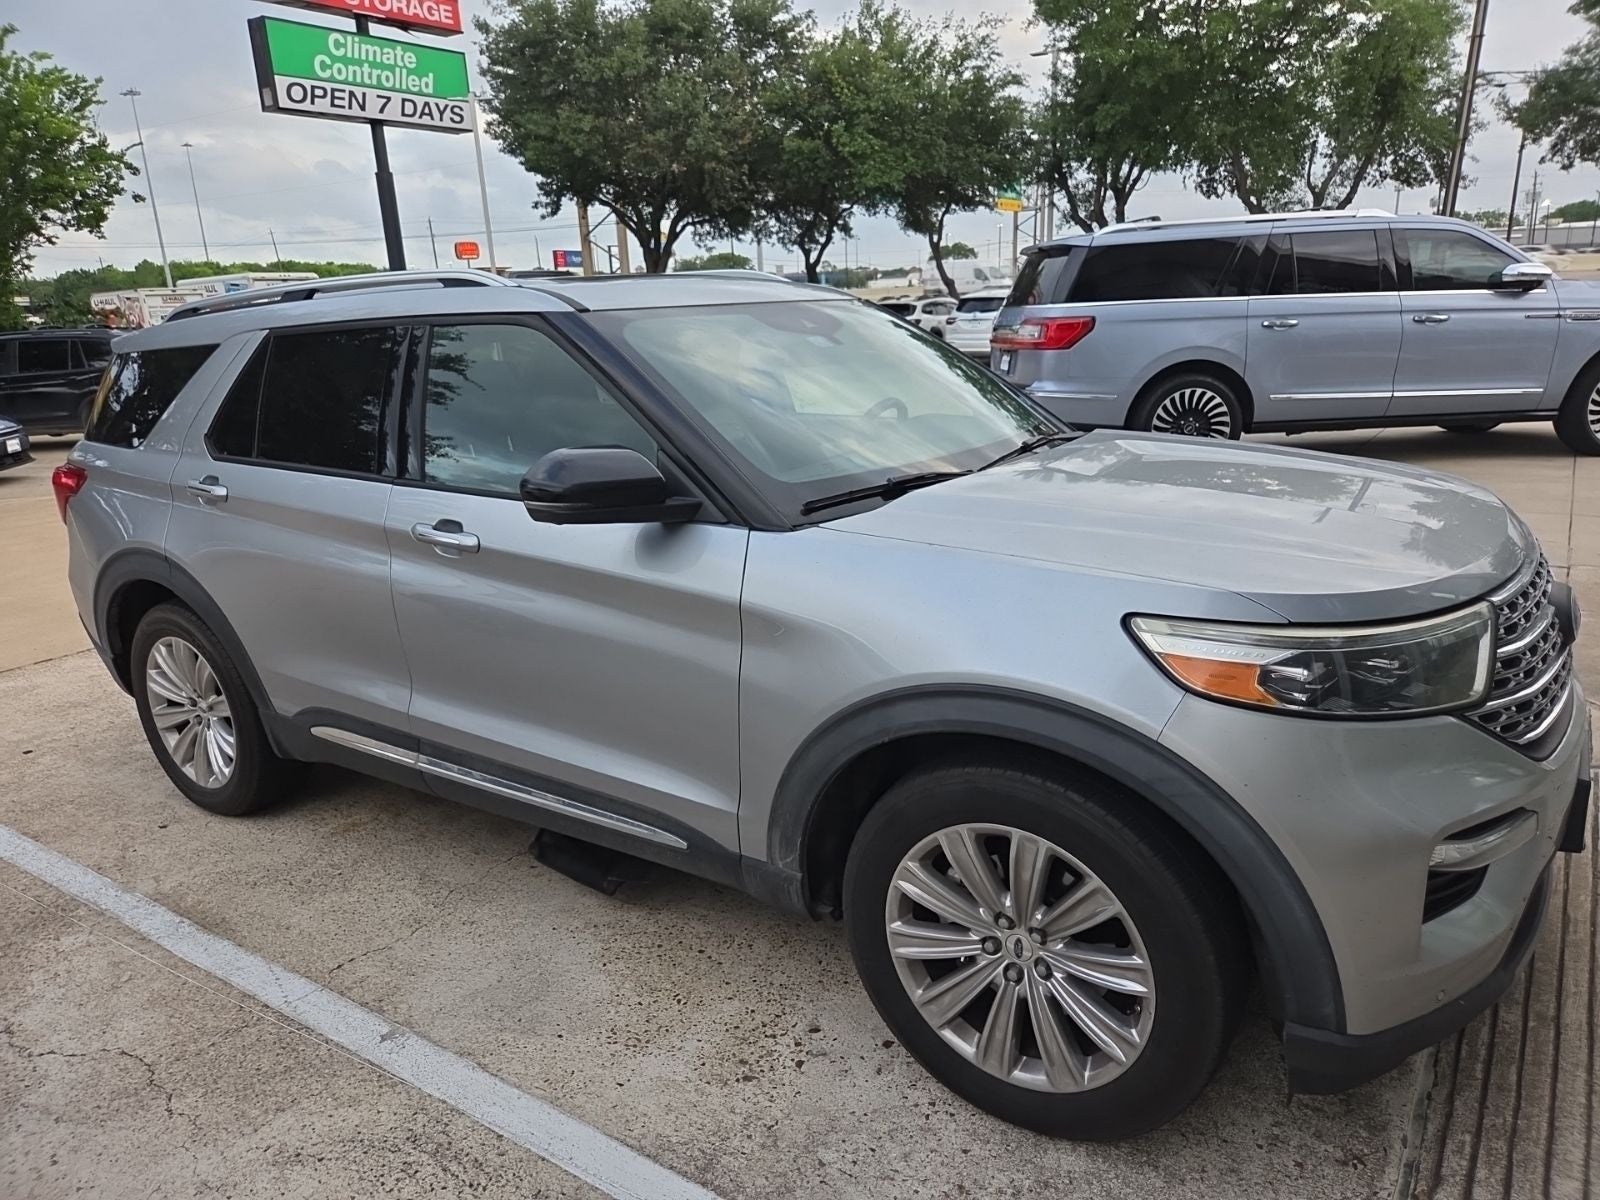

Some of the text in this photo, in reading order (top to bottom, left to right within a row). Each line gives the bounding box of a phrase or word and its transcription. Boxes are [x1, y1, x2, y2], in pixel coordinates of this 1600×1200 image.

[343, 0, 455, 24] ORAGE
[328, 33, 417, 68] Climate
[315, 54, 434, 94] Controlled
[286, 82, 465, 124] OPEN 7 DAYS
